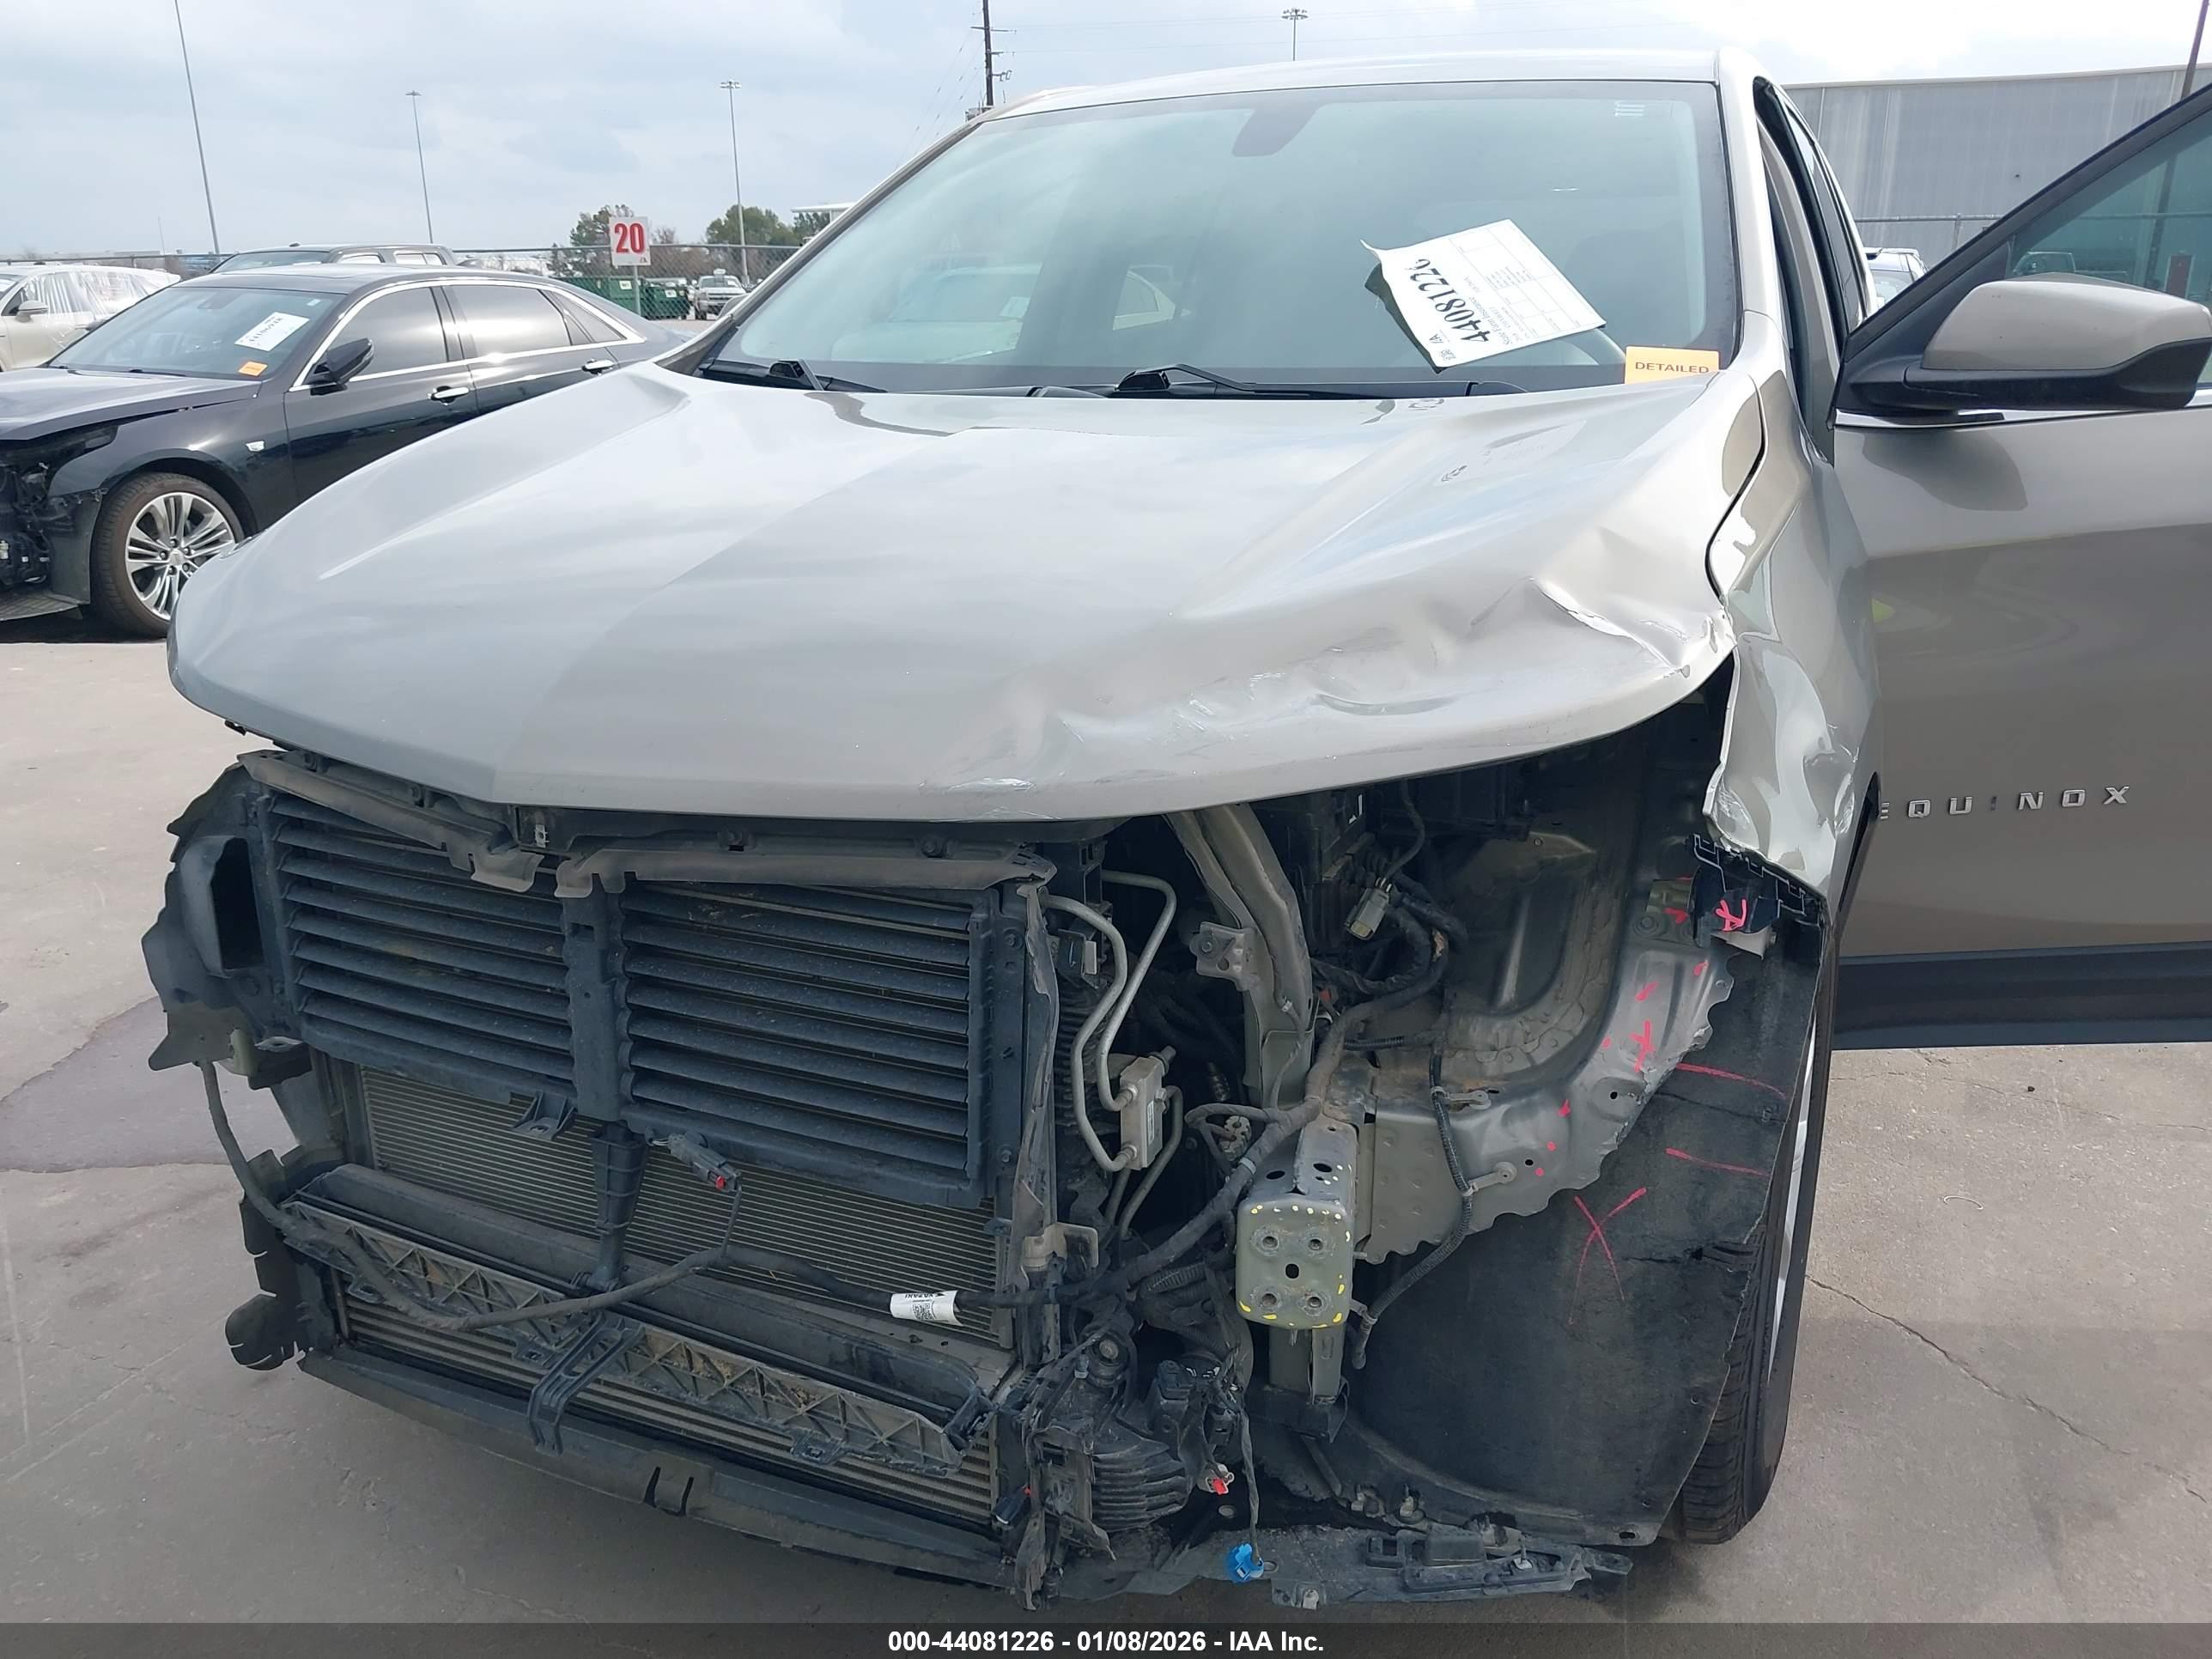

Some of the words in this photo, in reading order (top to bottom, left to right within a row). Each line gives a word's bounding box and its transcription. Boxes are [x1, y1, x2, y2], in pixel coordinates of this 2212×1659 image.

[614, 223, 644, 253] 20
[1407, 258, 1491, 343] 44081226
[1635, 362, 1710, 374] DETAILED
